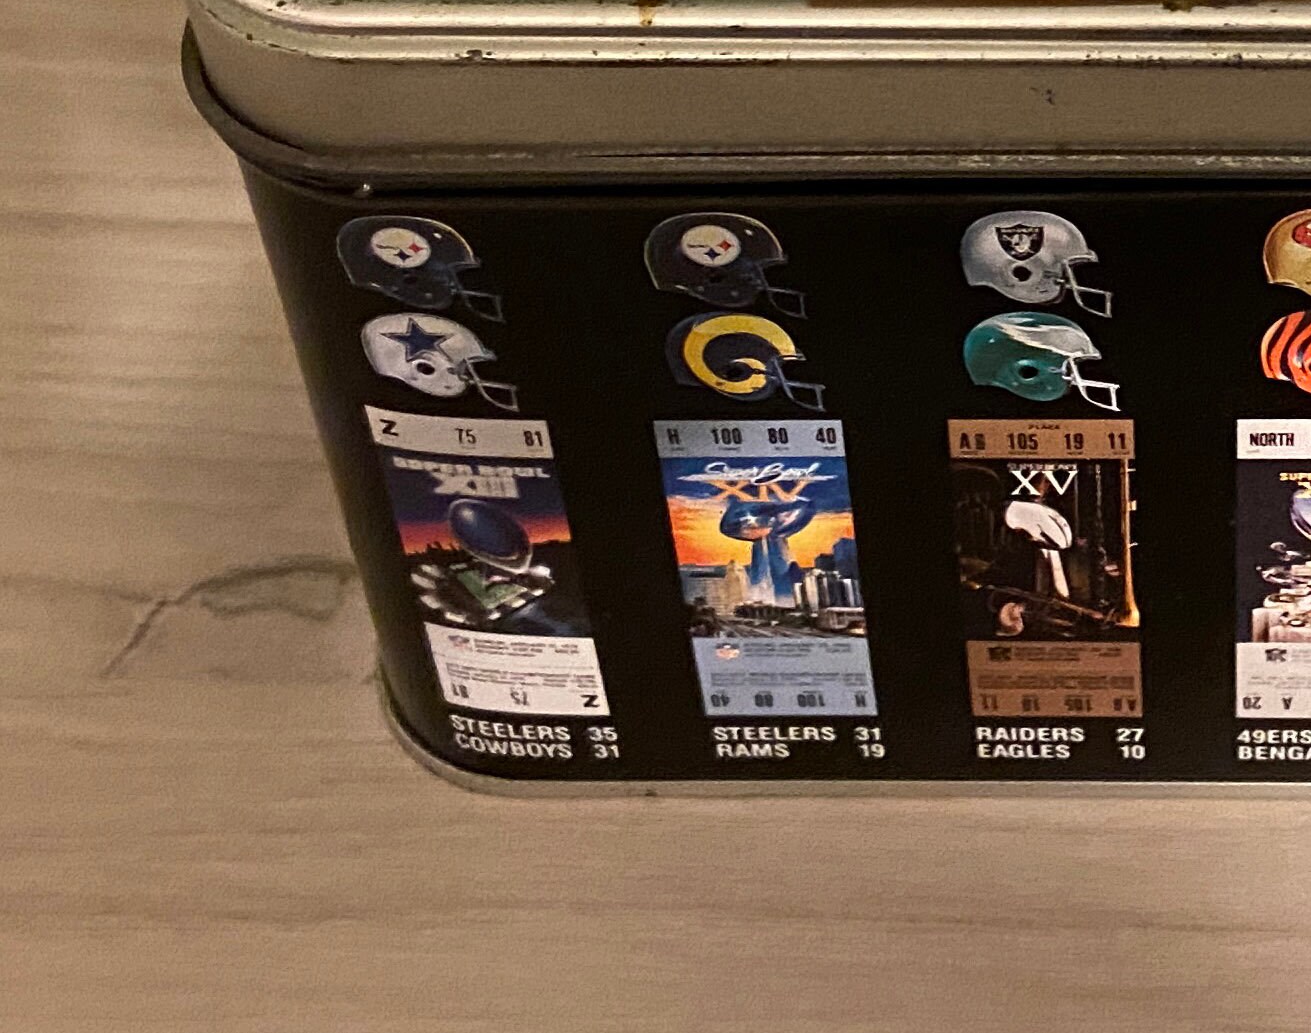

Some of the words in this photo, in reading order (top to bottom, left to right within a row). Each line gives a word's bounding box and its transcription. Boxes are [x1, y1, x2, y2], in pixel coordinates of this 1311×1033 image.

[379, 419, 399, 437] Z
[523, 430, 543, 447] 81
[666, 428, 681, 445] H
[711, 427, 743, 445] 100
[815, 427, 837, 445] 40
[1007, 432, 1039, 450] 105
[1064, 432, 1084, 450] 19
[1108, 432, 1127, 450] 11
[1249, 432, 1295, 447] NORTH
[706, 479, 812, 503] XIV
[1011, 470, 1079, 496] XV
[450, 714, 572, 741] STEELERS
[587, 726, 619, 742] 35
[712, 726, 837, 742] STEELERS
[854, 726, 882, 742] 31
[975, 726, 1085, 742] RAIDERS
[1116, 727, 1145, 742] 27
[455, 732, 573, 759] COWBOYS
[594, 744, 620, 759] 31
[716, 743, 790, 758] RAMS
[858, 743, 886, 758] 19
[977, 743, 1070, 759] EAGLES
[1119, 744, 1146, 759] 10
